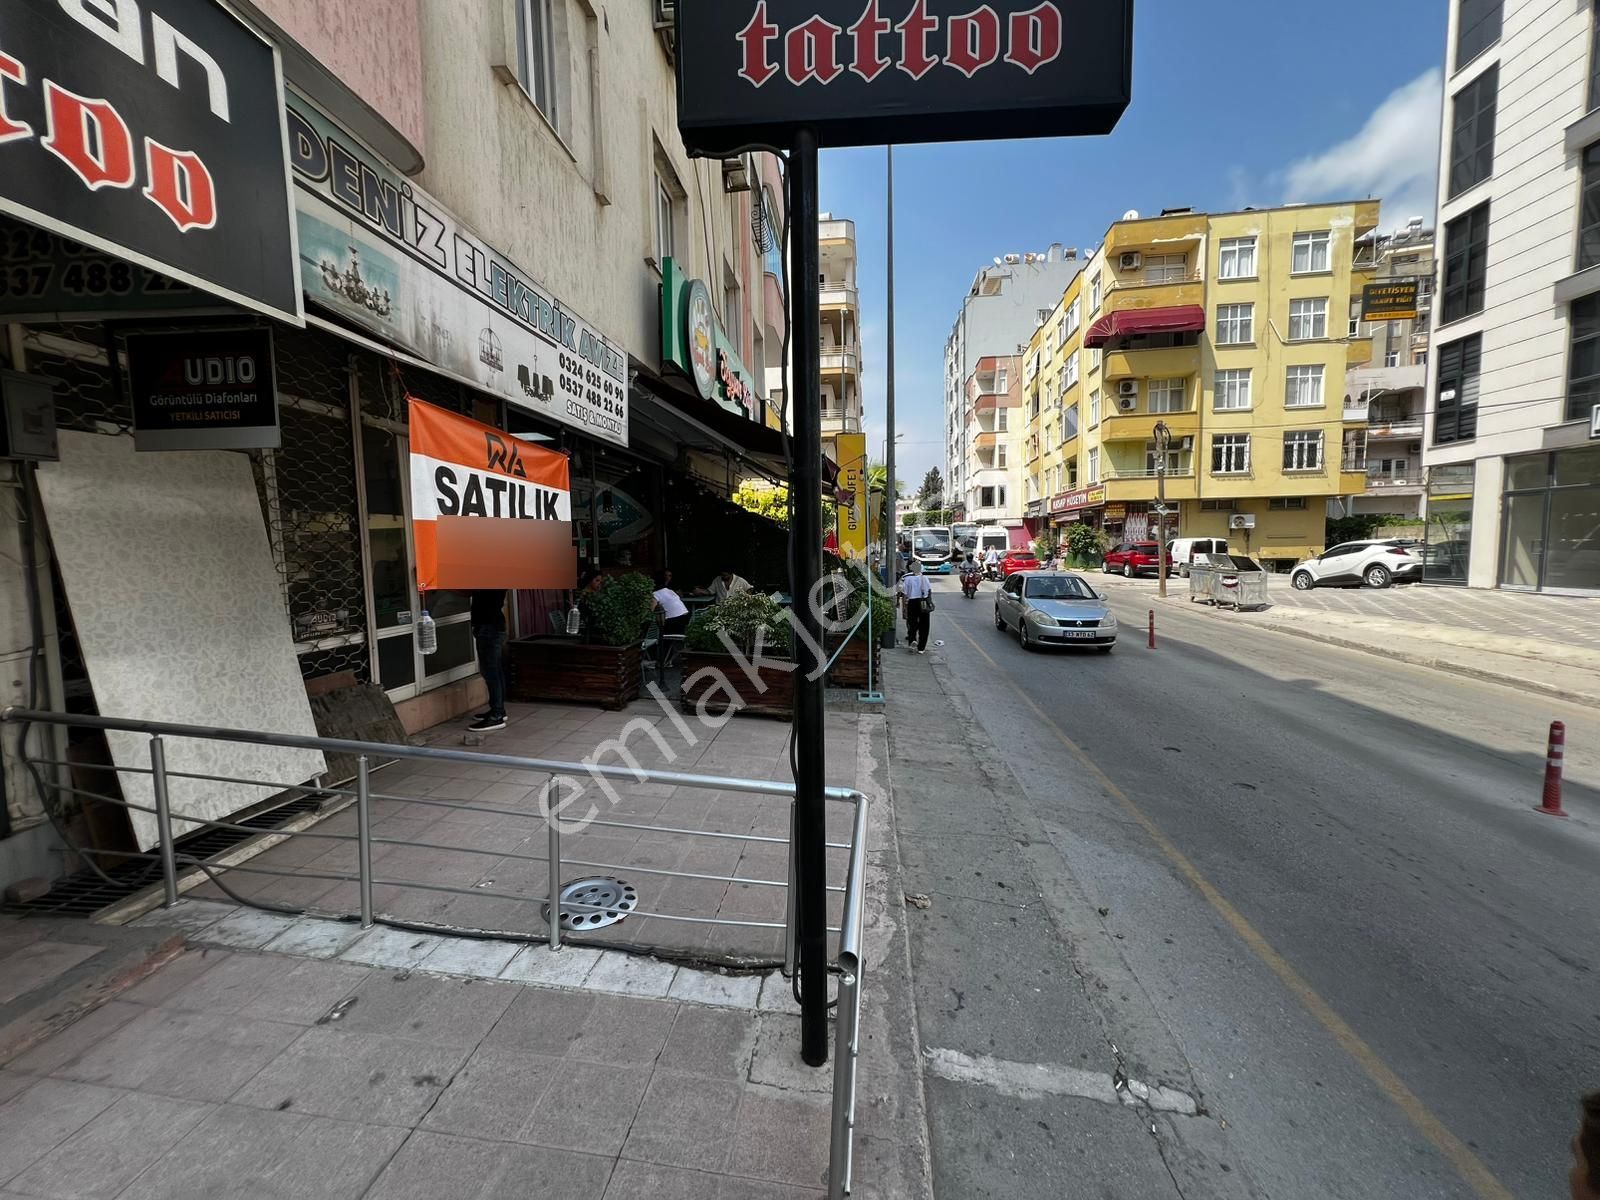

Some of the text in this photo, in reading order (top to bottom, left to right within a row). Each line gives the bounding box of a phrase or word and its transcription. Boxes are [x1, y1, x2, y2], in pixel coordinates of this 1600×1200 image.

[736, 0, 1062, 88] tattoo
[286, 104, 447, 270] DENİZ
[453, 231, 576, 352] ELEKTRİK
[149, 391, 258, 406] Görüntülü Diafonları
[559, 352, 624, 402] 0324 625 60 90
[559, 373, 624, 418] 0537 488 22 66
[566, 398, 622, 435] SATIŞ & MONTAJ
[434, 465, 559, 521] SATILIK
